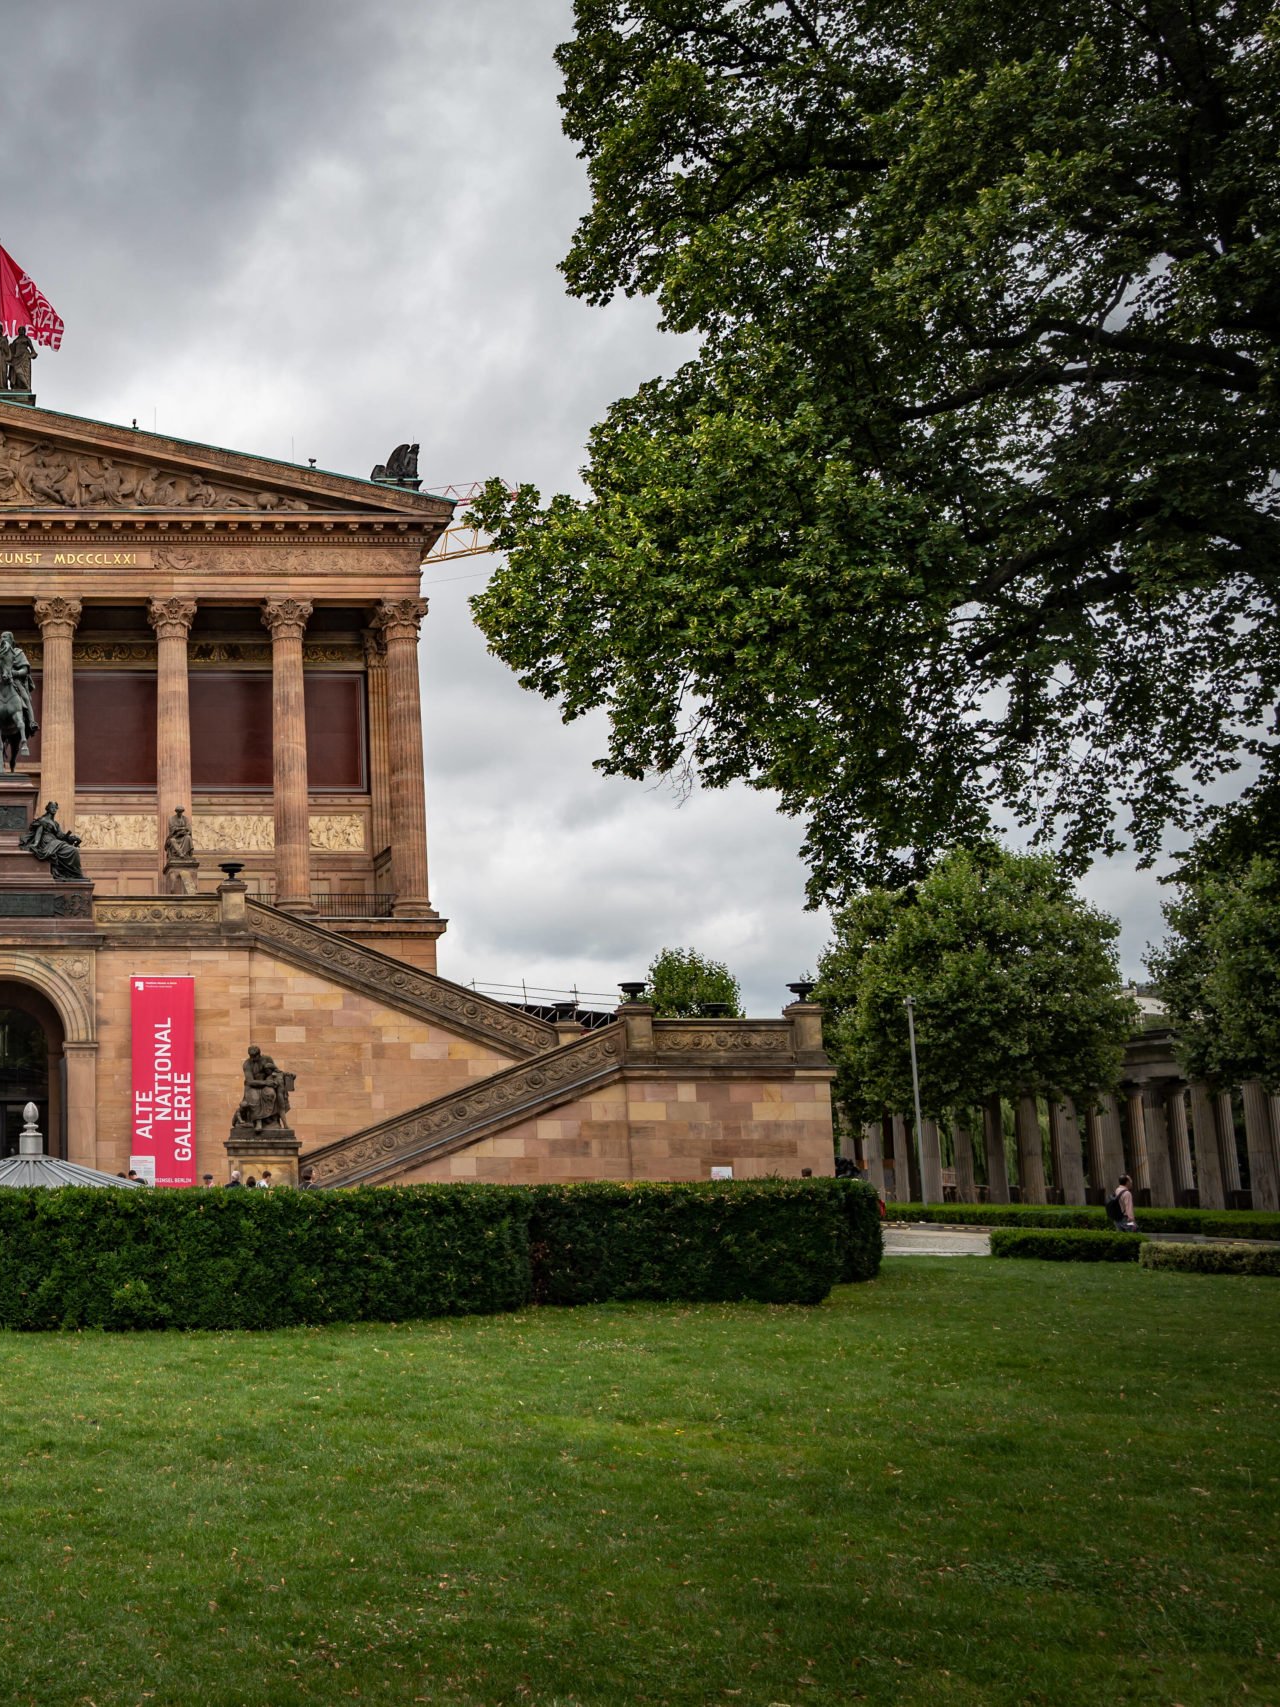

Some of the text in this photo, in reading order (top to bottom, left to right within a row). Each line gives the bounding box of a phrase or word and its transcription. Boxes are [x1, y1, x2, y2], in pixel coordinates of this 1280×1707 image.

[54, 553, 136, 565] MDCCCLXXI
[154, 1017, 172, 1121] NATIONAL
[135, 1090, 153, 1139] ALTE
[174, 1072, 192, 1161] GALERIE
